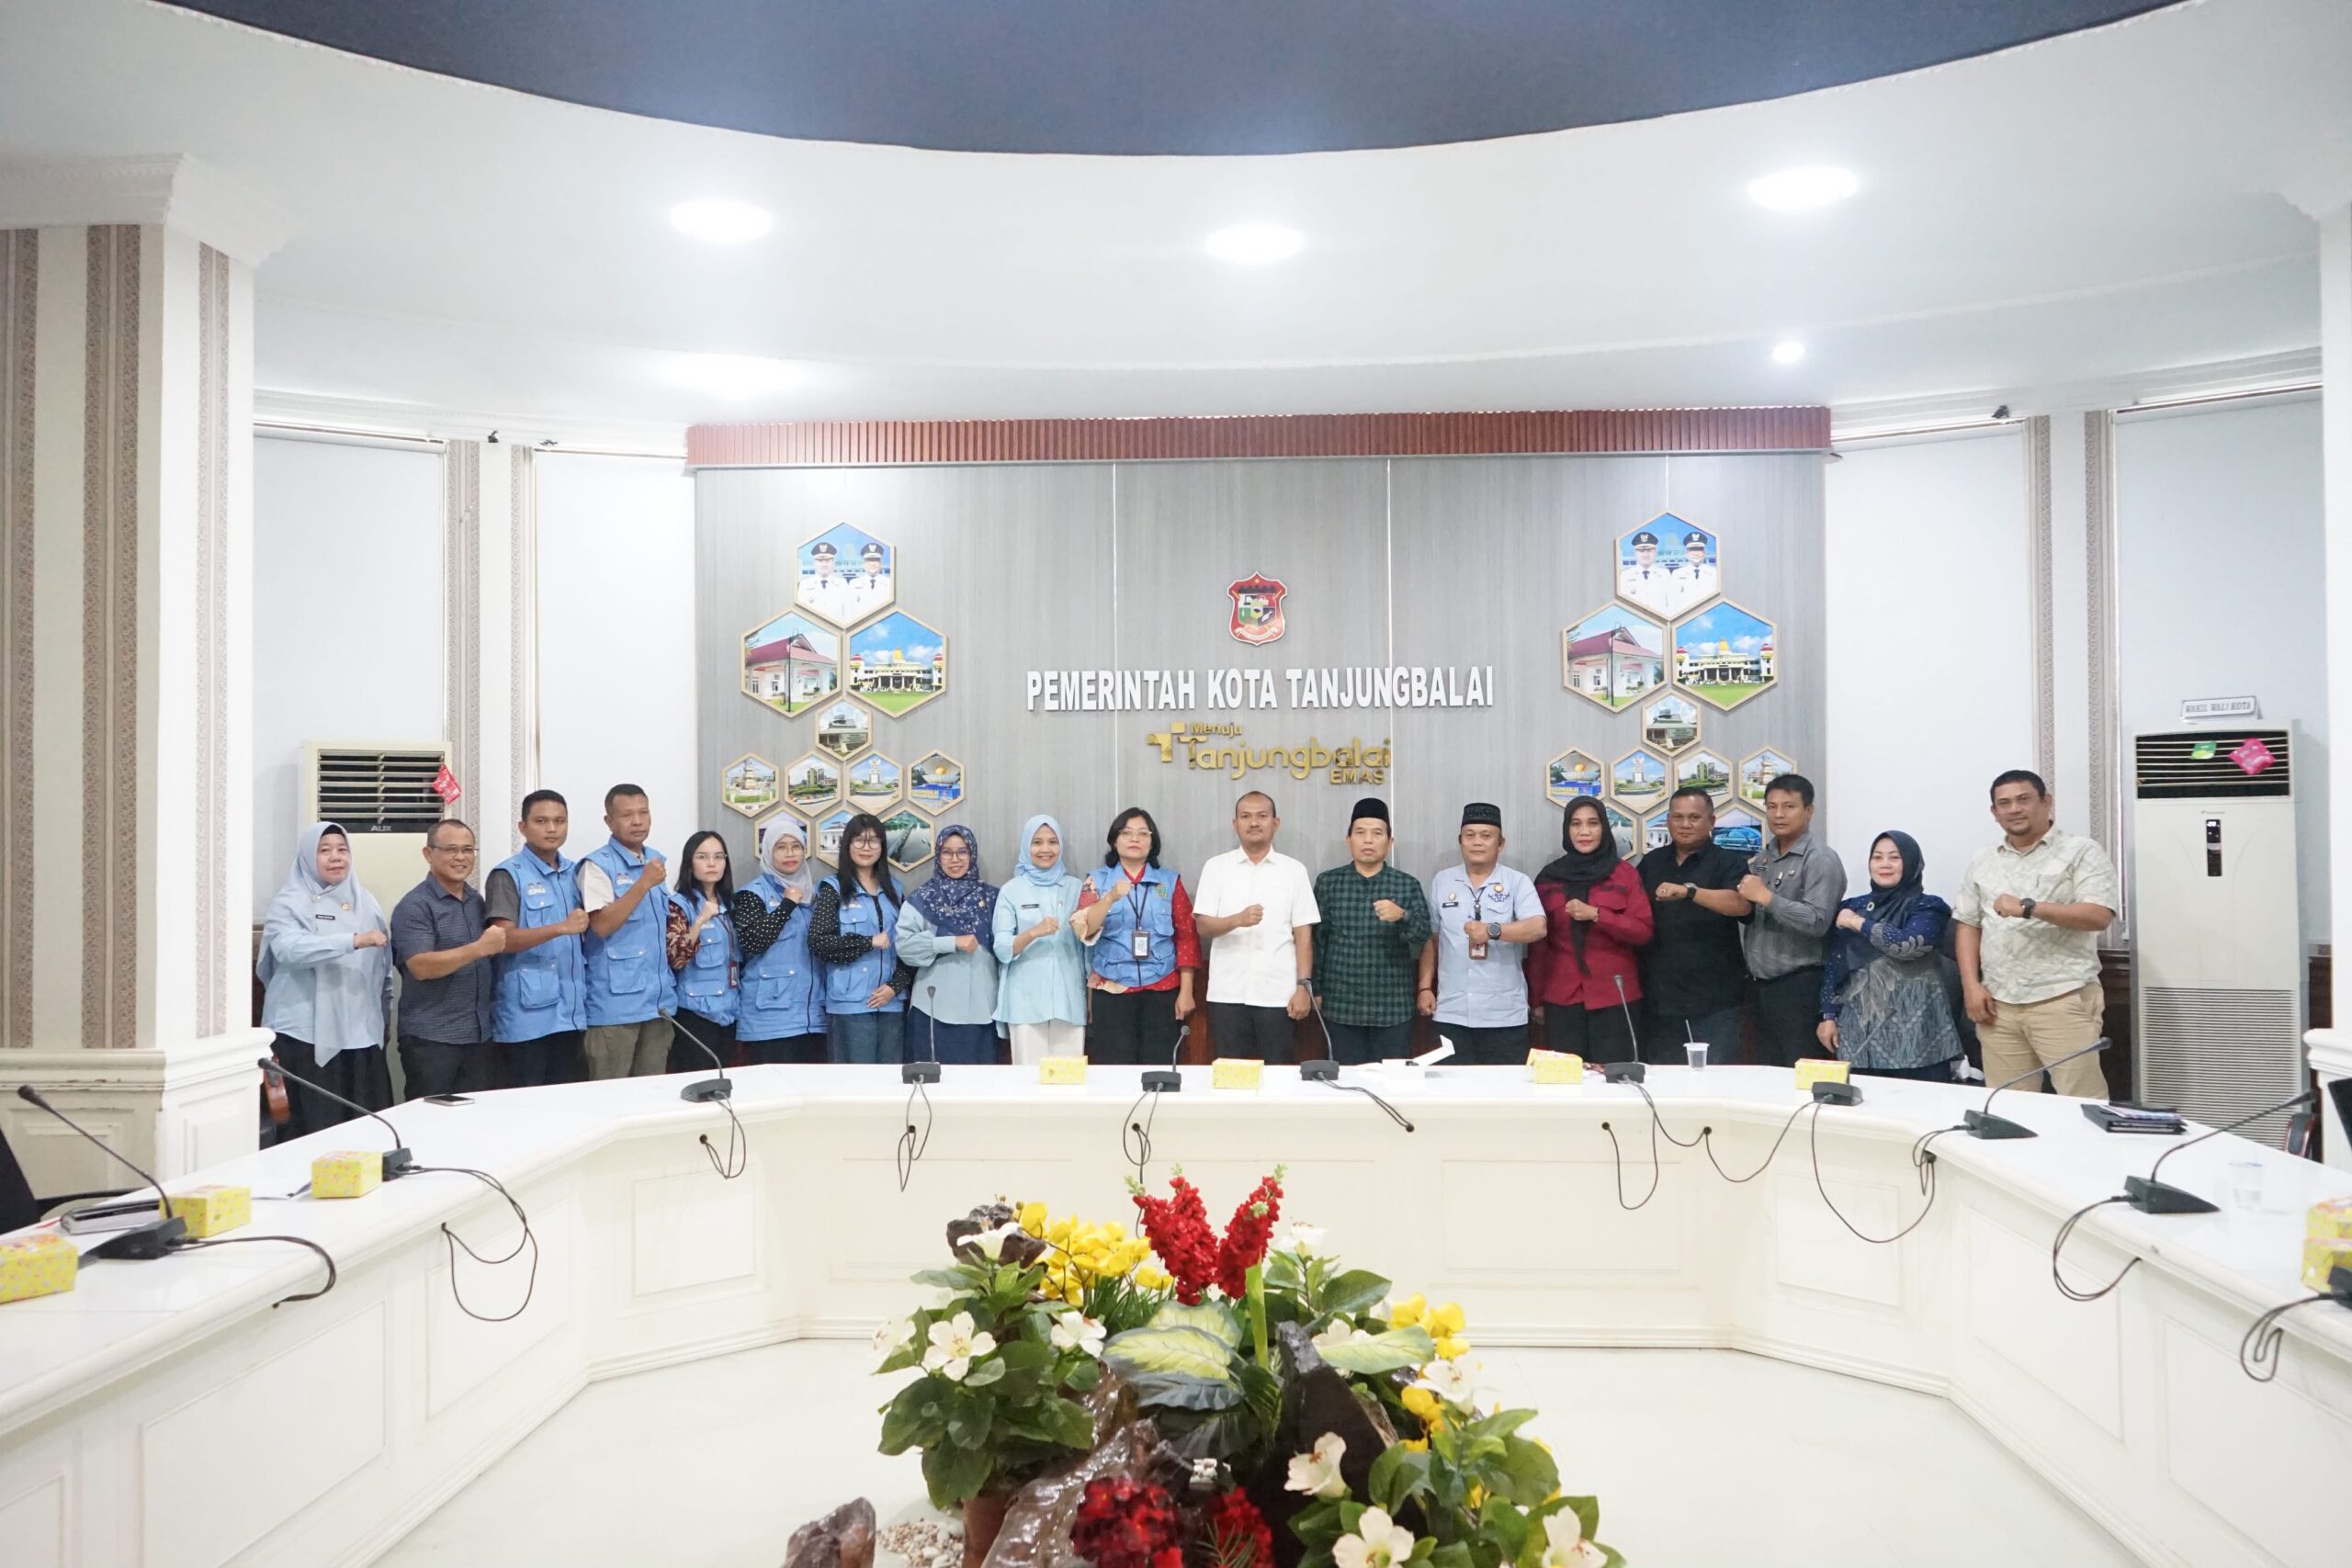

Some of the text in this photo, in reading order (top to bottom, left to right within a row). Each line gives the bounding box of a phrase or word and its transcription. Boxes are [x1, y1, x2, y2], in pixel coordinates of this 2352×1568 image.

[1026, 665, 1494, 712] PEMERINTAH KOTA TANJUNGBALAI
[1191, 722, 1244, 737] Menuju
[1177, 735, 1391, 780] Tanjungbalai
[1329, 768, 1386, 785] EMAS
